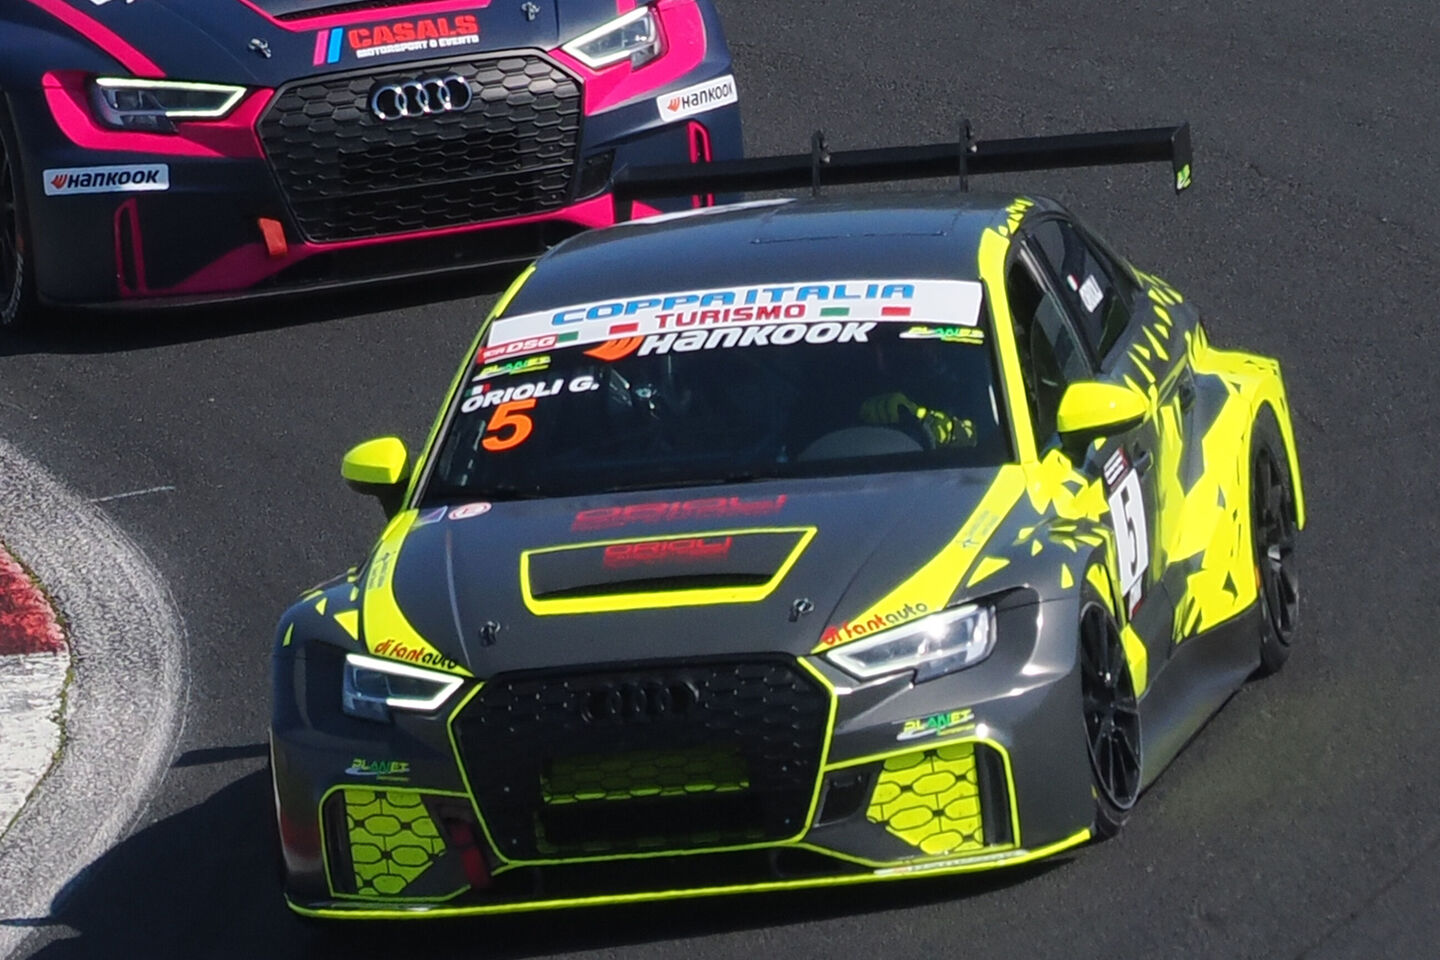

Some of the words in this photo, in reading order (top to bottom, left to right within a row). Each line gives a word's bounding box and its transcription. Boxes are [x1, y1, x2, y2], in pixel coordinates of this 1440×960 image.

[348, 14, 479, 49] CASALS
[655, 304, 806, 329] TURISMO
[505, 335, 557, 354] DSG
[461, 378, 564, 414] ORIOLI
[568, 376, 600, 393] G.
[482, 397, 538, 452] 5
